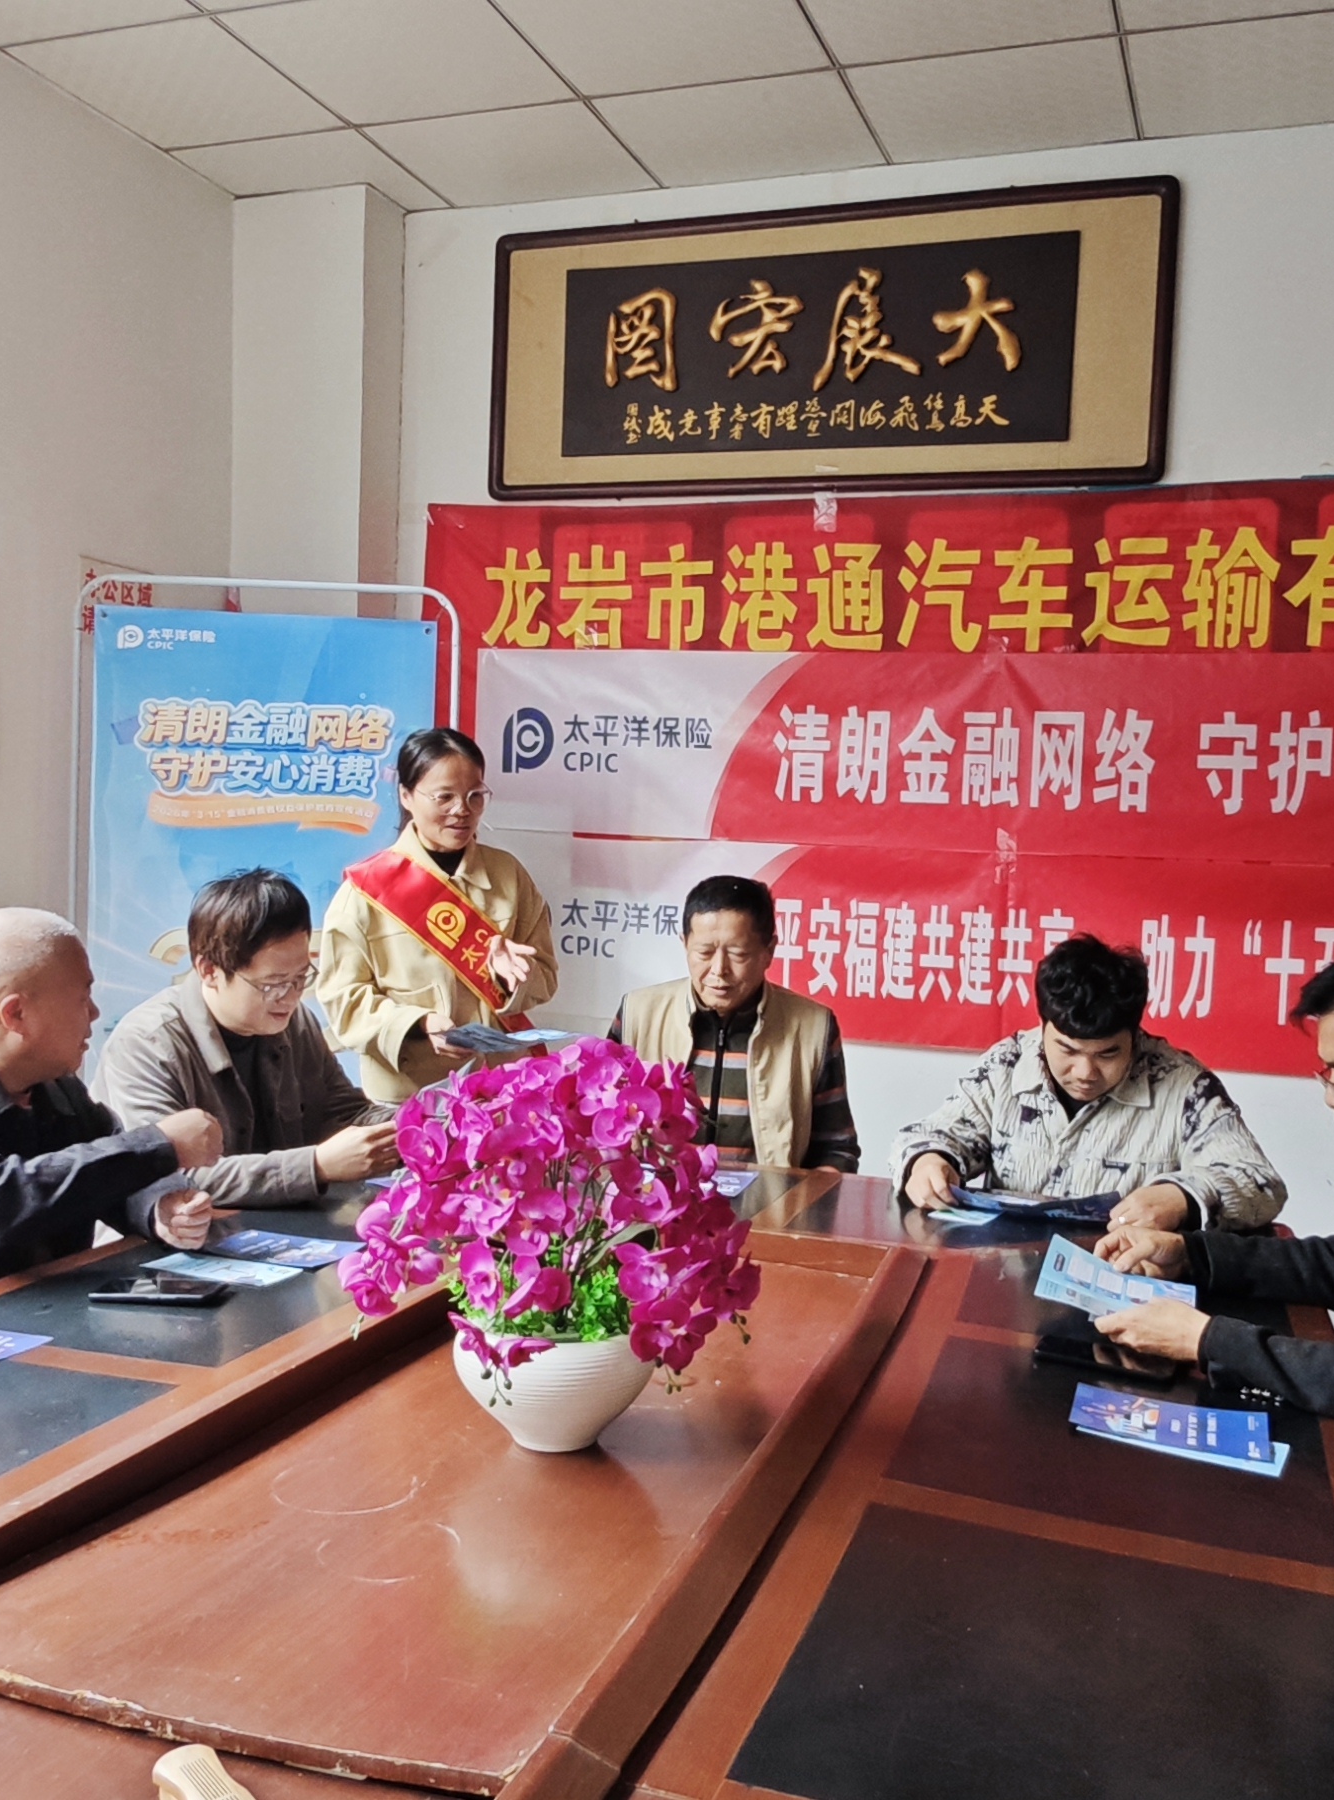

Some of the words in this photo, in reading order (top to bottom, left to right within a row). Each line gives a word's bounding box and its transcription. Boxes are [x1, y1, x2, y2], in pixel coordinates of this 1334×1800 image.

[147, 627, 216, 644] 太平洋保险
[147, 641, 175, 651] CPIC
[139, 700, 393, 751] 清朗金融网络
[563, 713, 713, 751] 太平洋保险
[150, 748, 376, 797] 守护安心消费
[563, 751, 619, 774] CPIC
[772, 703, 1157, 815] 清朗金融网络
[560, 898, 679, 937] 太平洋保
[560, 934, 617, 959] CPIC
